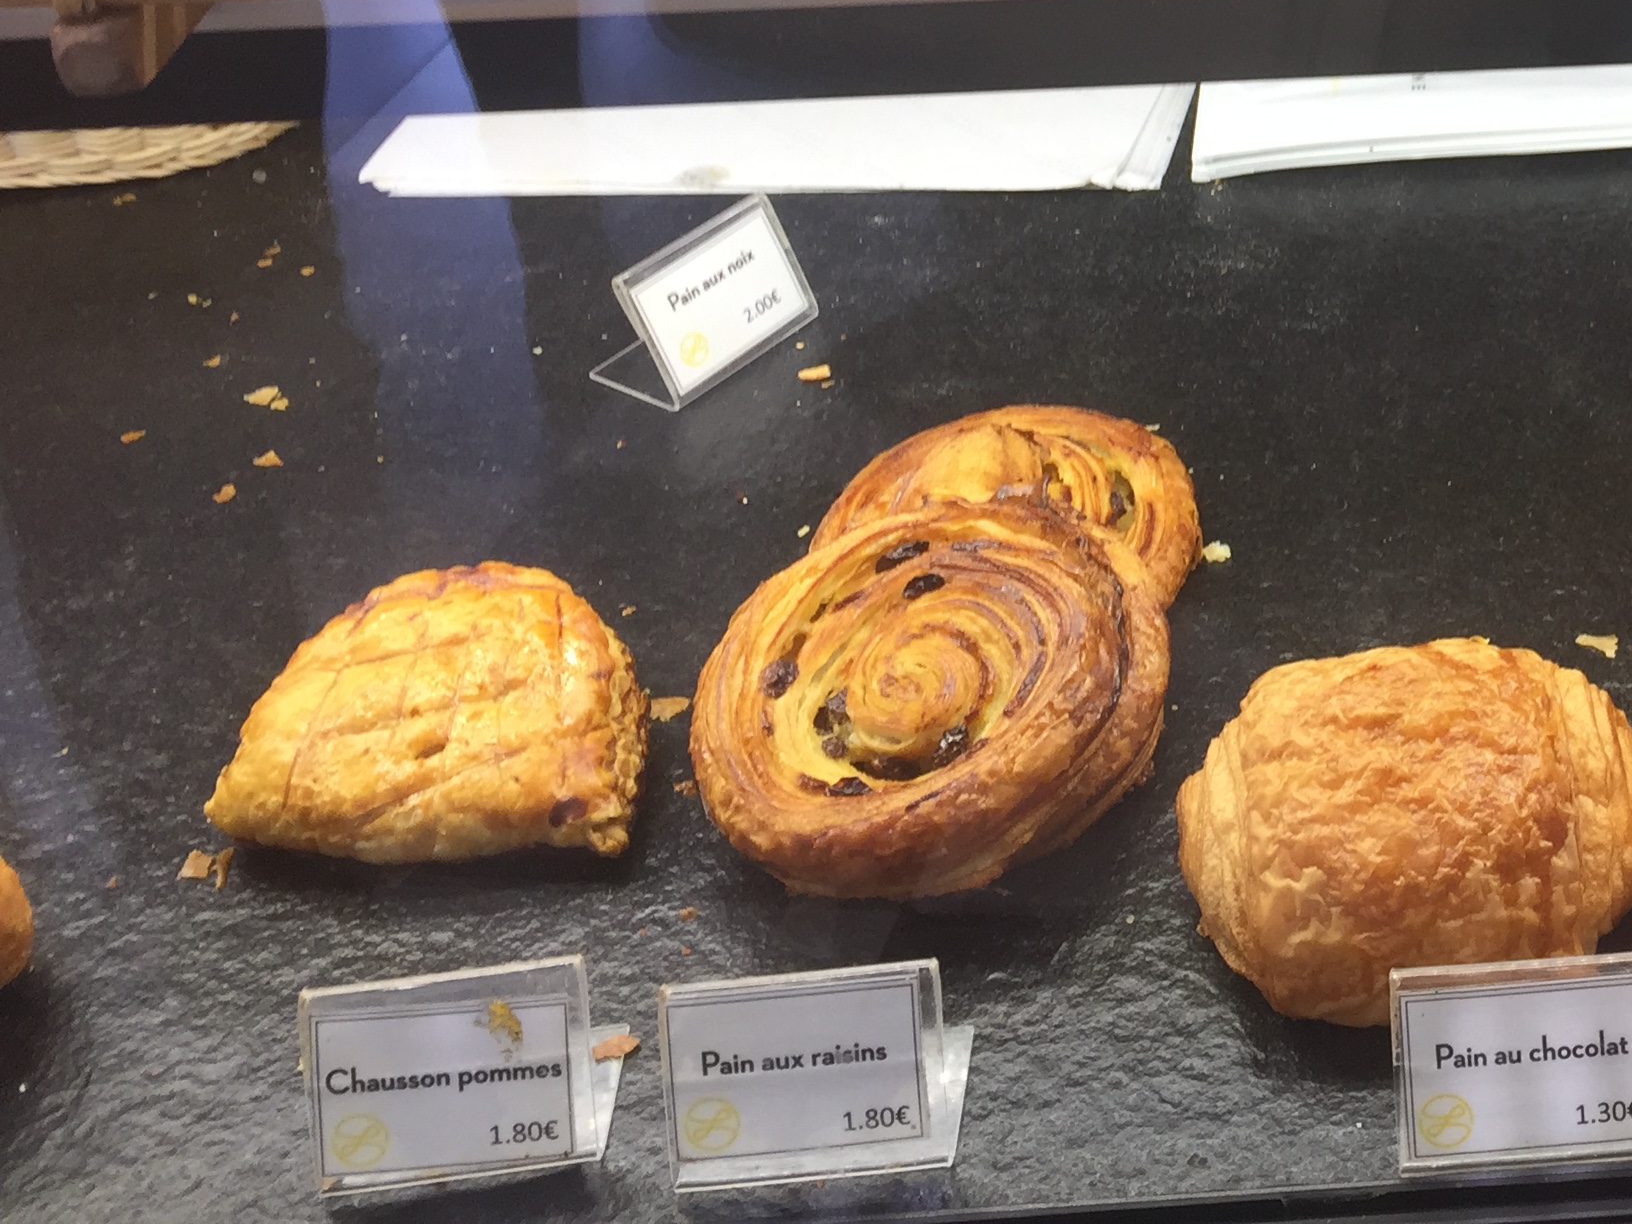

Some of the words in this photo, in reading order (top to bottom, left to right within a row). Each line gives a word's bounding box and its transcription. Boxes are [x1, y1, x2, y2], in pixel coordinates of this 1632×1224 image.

[667, 283, 701, 313] Pain
[702, 268, 727, 294] aux
[727, 247, 756, 277] noix
[742, 287, 783, 325] 2.00€
[700, 1050, 755, 1077] Pain
[761, 1052, 805, 1072] aux
[811, 1042, 888, 1067] raisins
[1435, 1042, 1488, 1070] Pain
[1494, 1049, 1522, 1066] au
[1529, 1029, 1630, 1063] chocolat
[325, 1067, 451, 1096] Chausson
[457, 1062, 563, 1093] pommes
[489, 1119, 560, 1146] 1.80€
[843, 1104, 911, 1132] 1.80€
